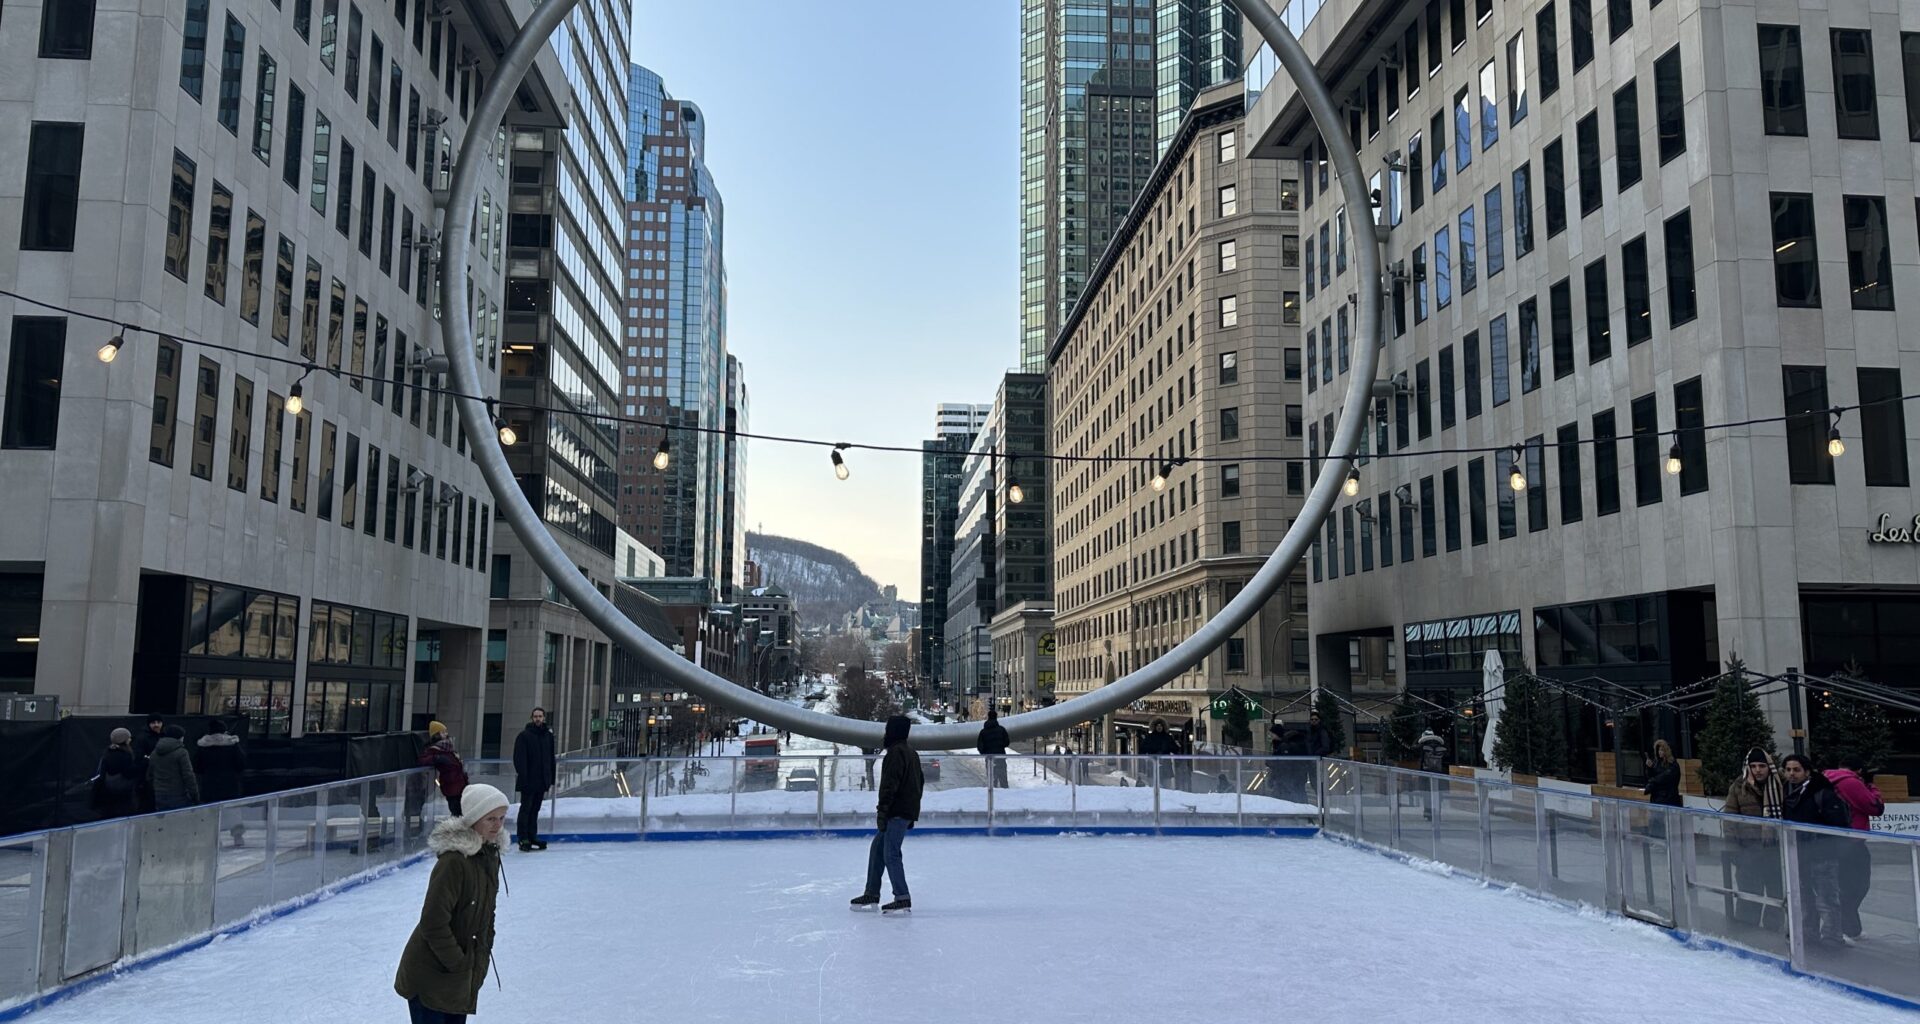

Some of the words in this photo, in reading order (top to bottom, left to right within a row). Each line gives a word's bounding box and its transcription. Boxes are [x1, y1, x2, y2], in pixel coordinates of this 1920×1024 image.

[1872, 512, 1910, 542] Les
[1213, 701, 1257, 711] TOY
[1883, 814, 1920, 822] ENFANTS
